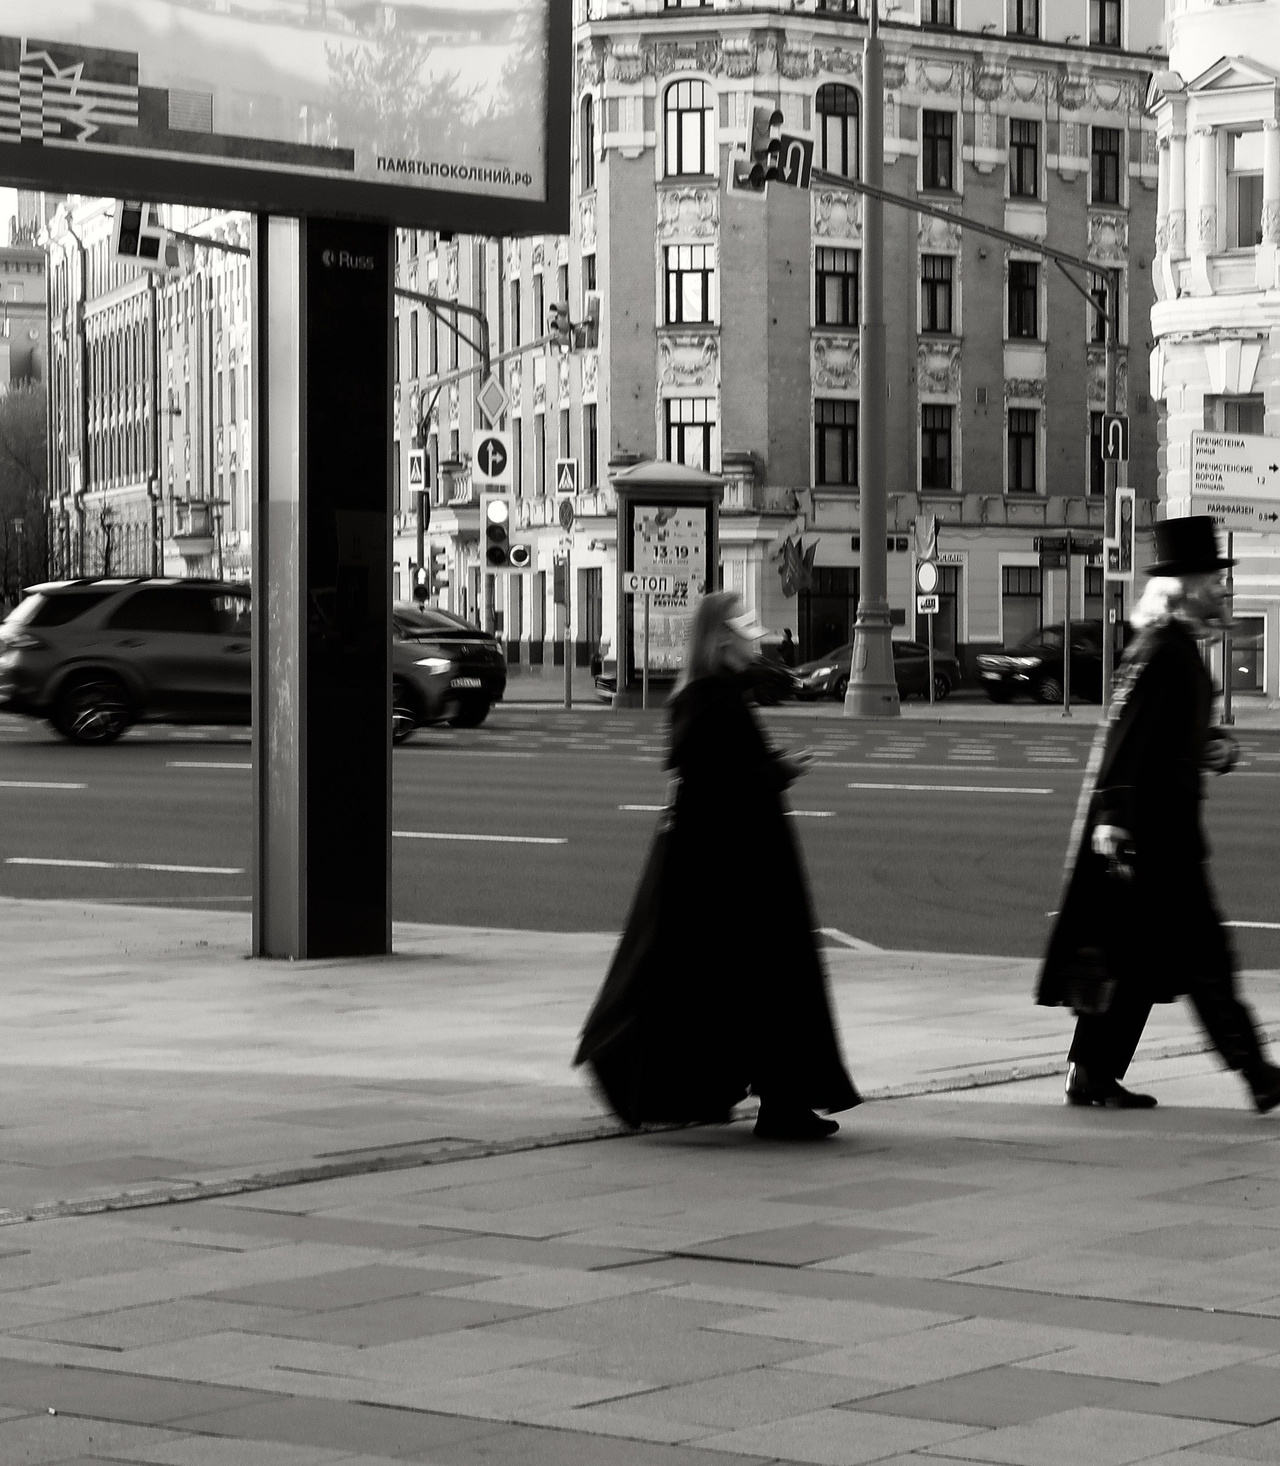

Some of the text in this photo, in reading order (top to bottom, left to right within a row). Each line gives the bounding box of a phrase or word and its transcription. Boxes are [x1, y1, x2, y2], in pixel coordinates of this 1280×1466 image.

[376, 156, 533, 188] ПАМЯТЬПОКОЛЕНИЙ.РФ
[339, 250, 374, 270] Russ
[1195, 436, 1246, 449] ПРЕЧИСТЕНКА
[1195, 447, 1216, 456] улица
[1195, 461, 1254, 475] ПРЕЧИСТЕНСКИЕ
[1195, 472, 1224, 483] ВОРОТА
[1195, 482, 1225, 491] площадь
[1206, 503, 1255, 515] РАЙФФАЙЗЕН
[629, 575, 668, 592] СТОП
